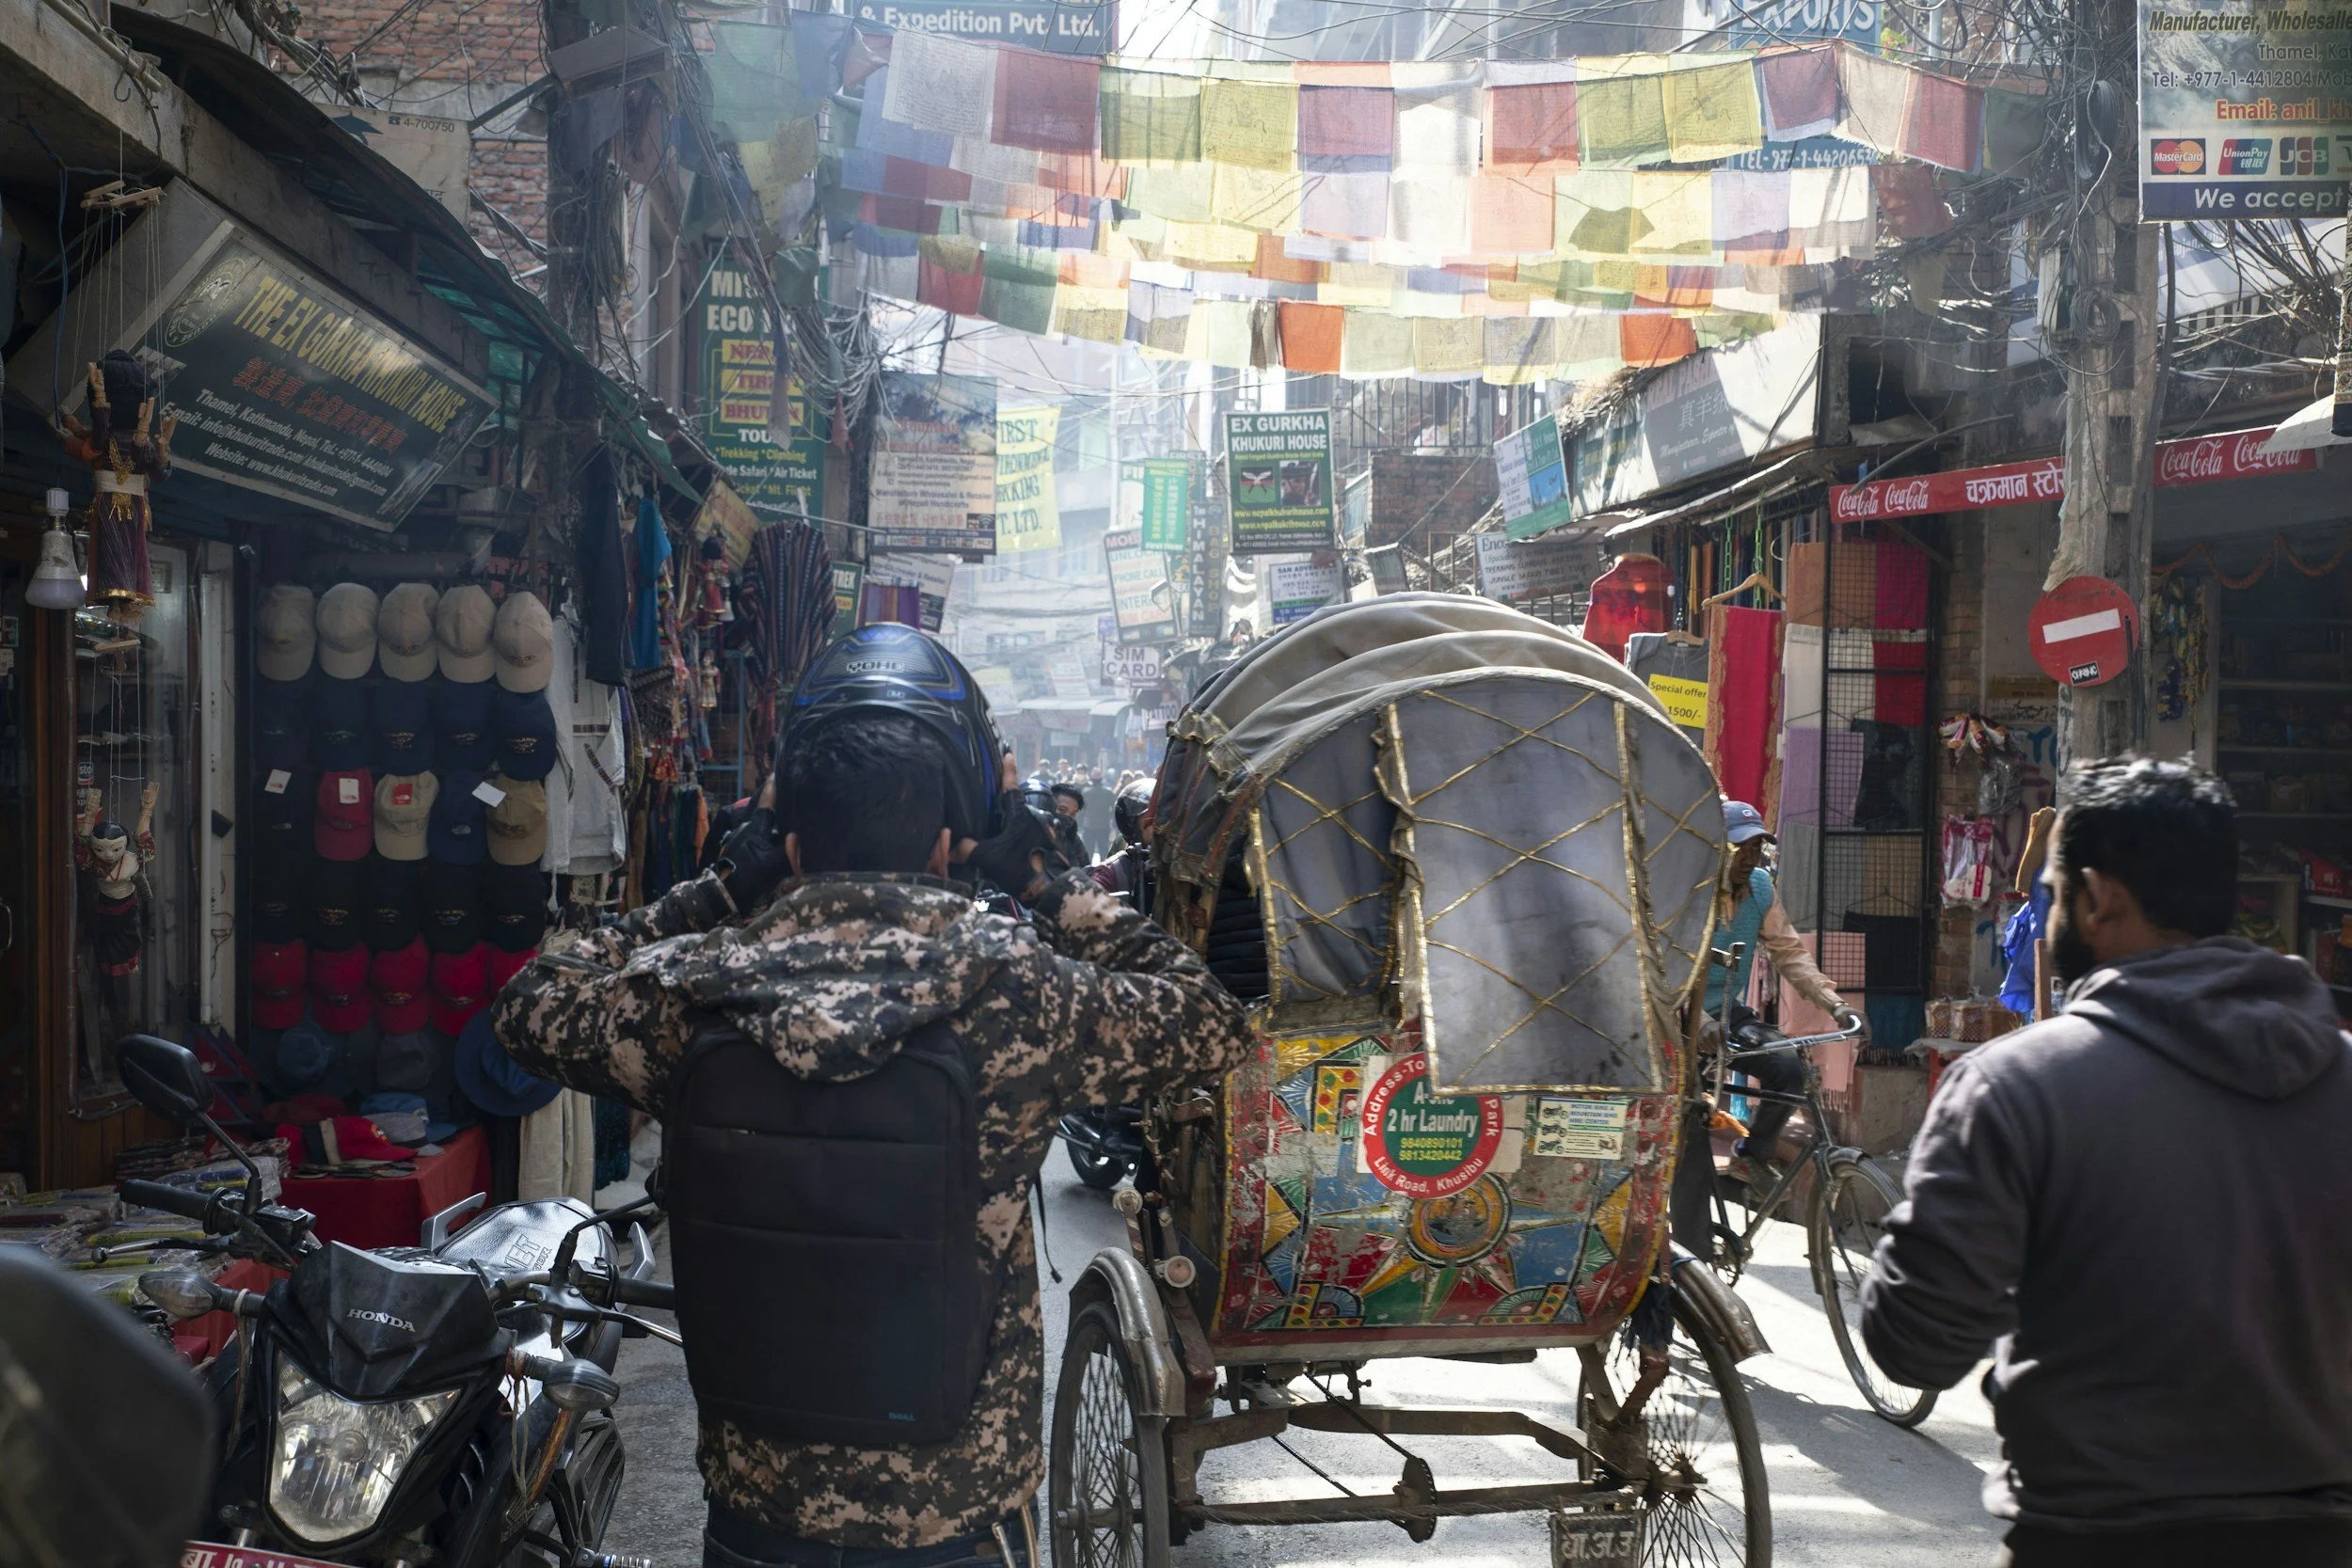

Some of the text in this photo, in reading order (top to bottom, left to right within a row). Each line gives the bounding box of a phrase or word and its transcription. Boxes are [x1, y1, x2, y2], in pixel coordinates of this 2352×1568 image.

[860, 7, 1101, 38] & Expedition Pvt. Ltd.
[2150, 10, 2262, 35] Manufacturer,
[2258, 43, 2323, 63] Thamel,
[2152, 71, 2180, 88] Tel:
[2184, 70, 2312, 88] +977-1-4412804
[2216, 98, 2278, 120] Email:
[403, 119, 455, 134] 4-700750
[2153, 150, 2203, 163] MasterCard
[2223, 147, 2268, 166] UnionPay
[2280, 148, 2328, 166] JCB
[2194, 186, 2344, 212] We accept
[707, 304, 755, 333] ECO
[233, 276, 298, 340] THE
[270, 297, 323, 352] EX
[297, 311, 374, 385] GURKHA
[357, 341, 430, 411] KHUKURI
[406, 377, 467, 434] HOUSE
[159, 402, 202, 430] E-mail:
[195, 388, 241, 417] Thamel,
[238, 406, 294, 440] Kathmandu,
[291, 429, 324, 451] Nepal,
[1232, 415, 1327, 434] EX GURKHA
[996, 420, 1038, 444] IRST
[1232, 434, 1327, 452] KHUKURI HOUSE
[204, 442, 250, 467] Website:
[2160, 441, 2226, 482] Coca-Cola
[1884, 480, 1931, 514] Coca-Cola
[1012, 509, 1042, 534] LTD.
[1192, 517, 1207, 622] HIMALAYAN
[1114, 646, 1145, 662] SIM
[1105, 662, 1157, 678] CARD
[1650, 681, 1708, 699] Special offer
[1387, 1108, 1479, 1138] 2 hr Laundry
[1485, 1098, 1501, 1136] Park
[1374, 1156, 1397, 1183] Link
[1436, 1158, 1485, 1192] Khusibu
[346, 1308, 416, 1333] HONDA
[888, 1412, 917, 1421] DELL
